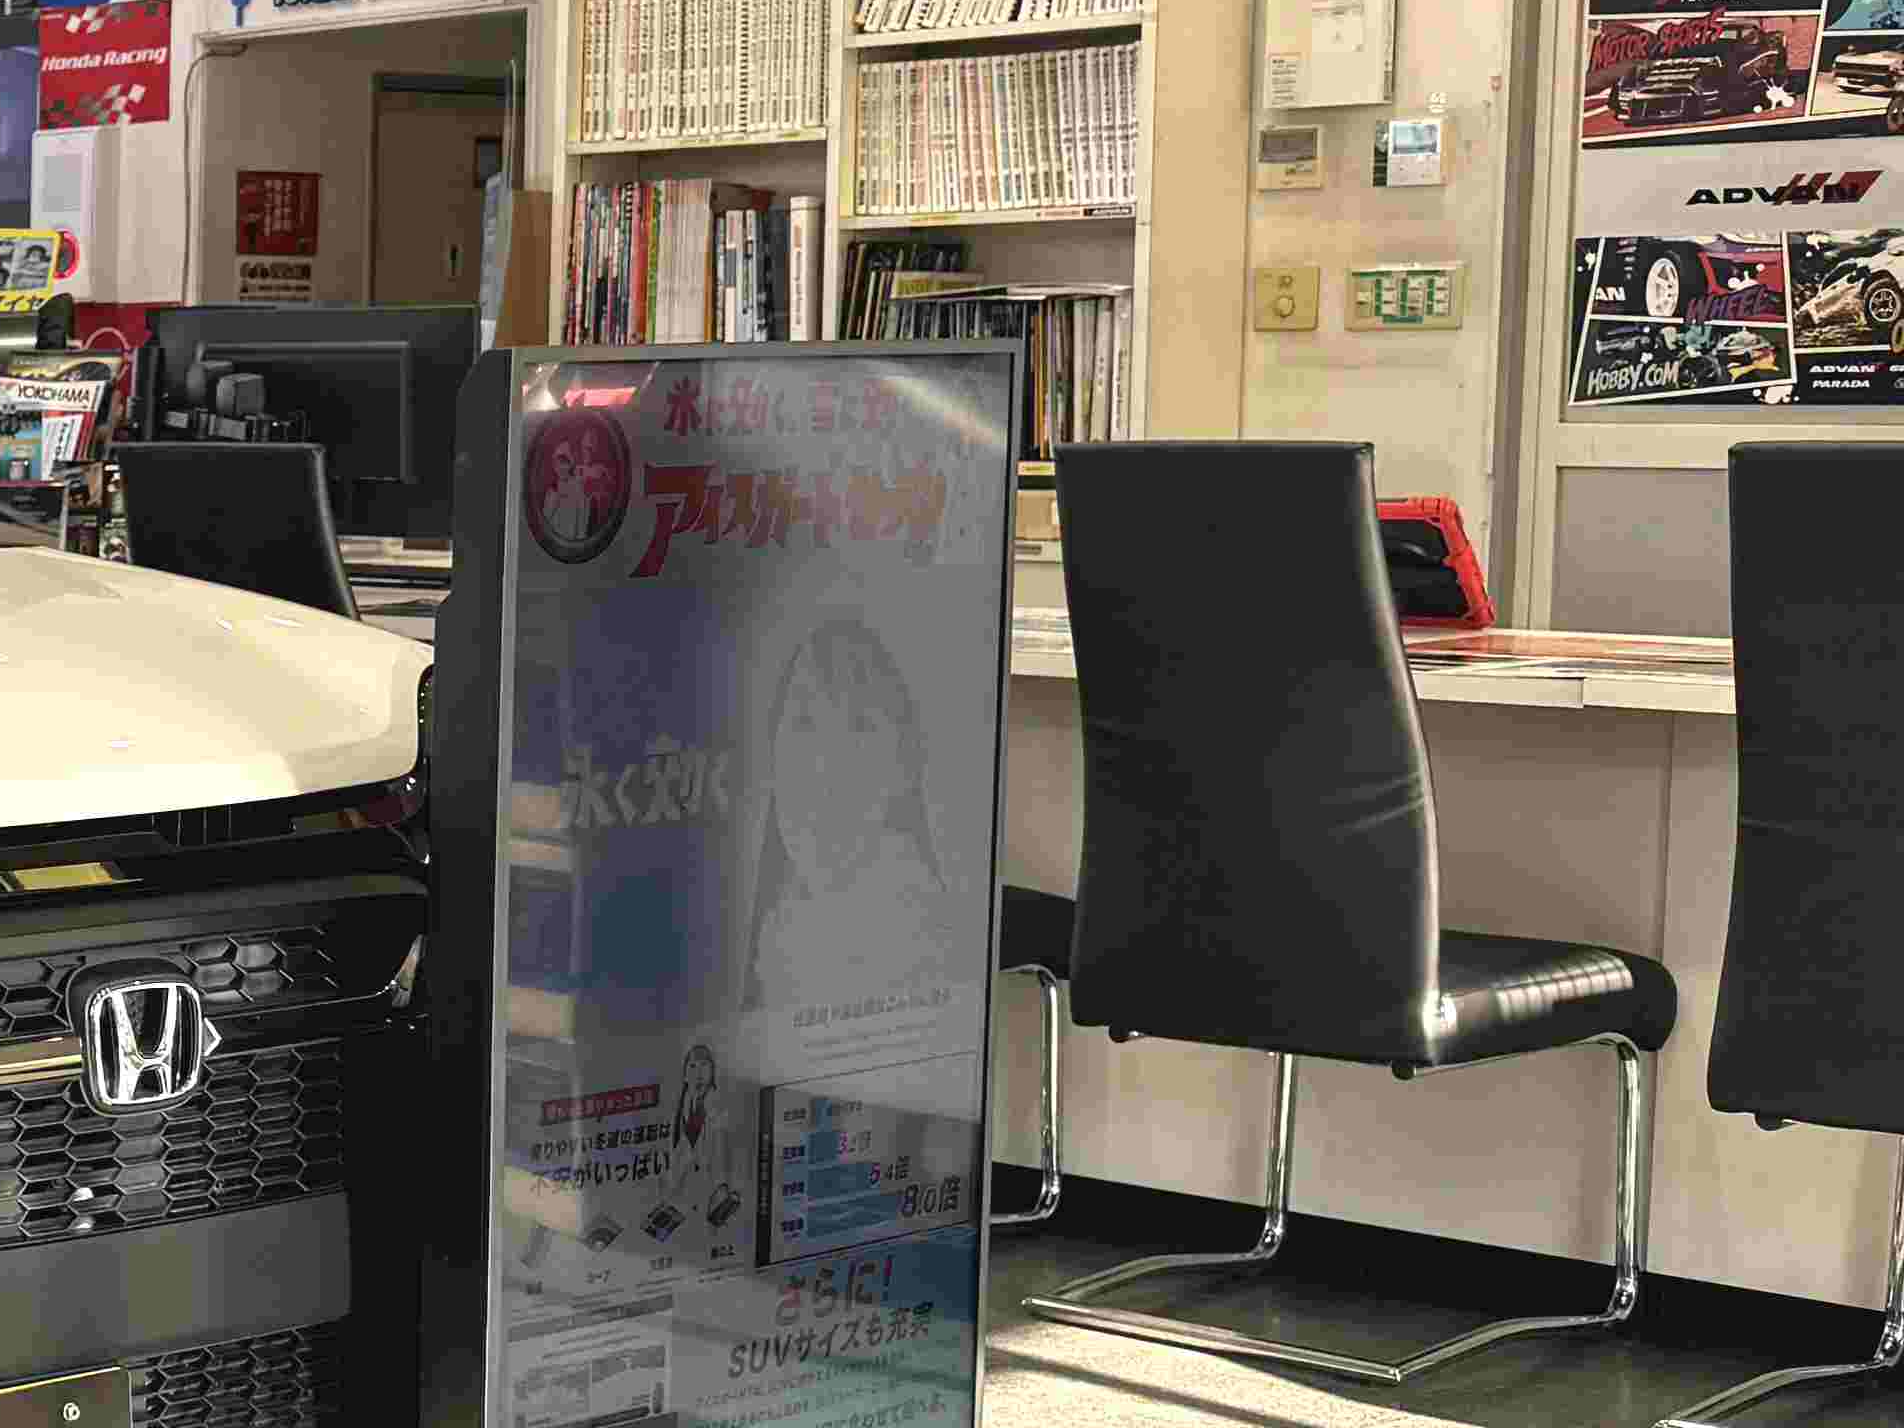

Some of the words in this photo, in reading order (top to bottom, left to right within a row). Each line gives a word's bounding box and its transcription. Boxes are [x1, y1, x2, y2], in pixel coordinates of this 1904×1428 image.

[41, 54, 102, 72] Honda
[103, 46, 168, 68] Racing
[1685, 186, 1860, 206] ADVAN
[16, 384, 91, 403] YOKOHAMA
[1811, 379, 1871, 389] PARADA
